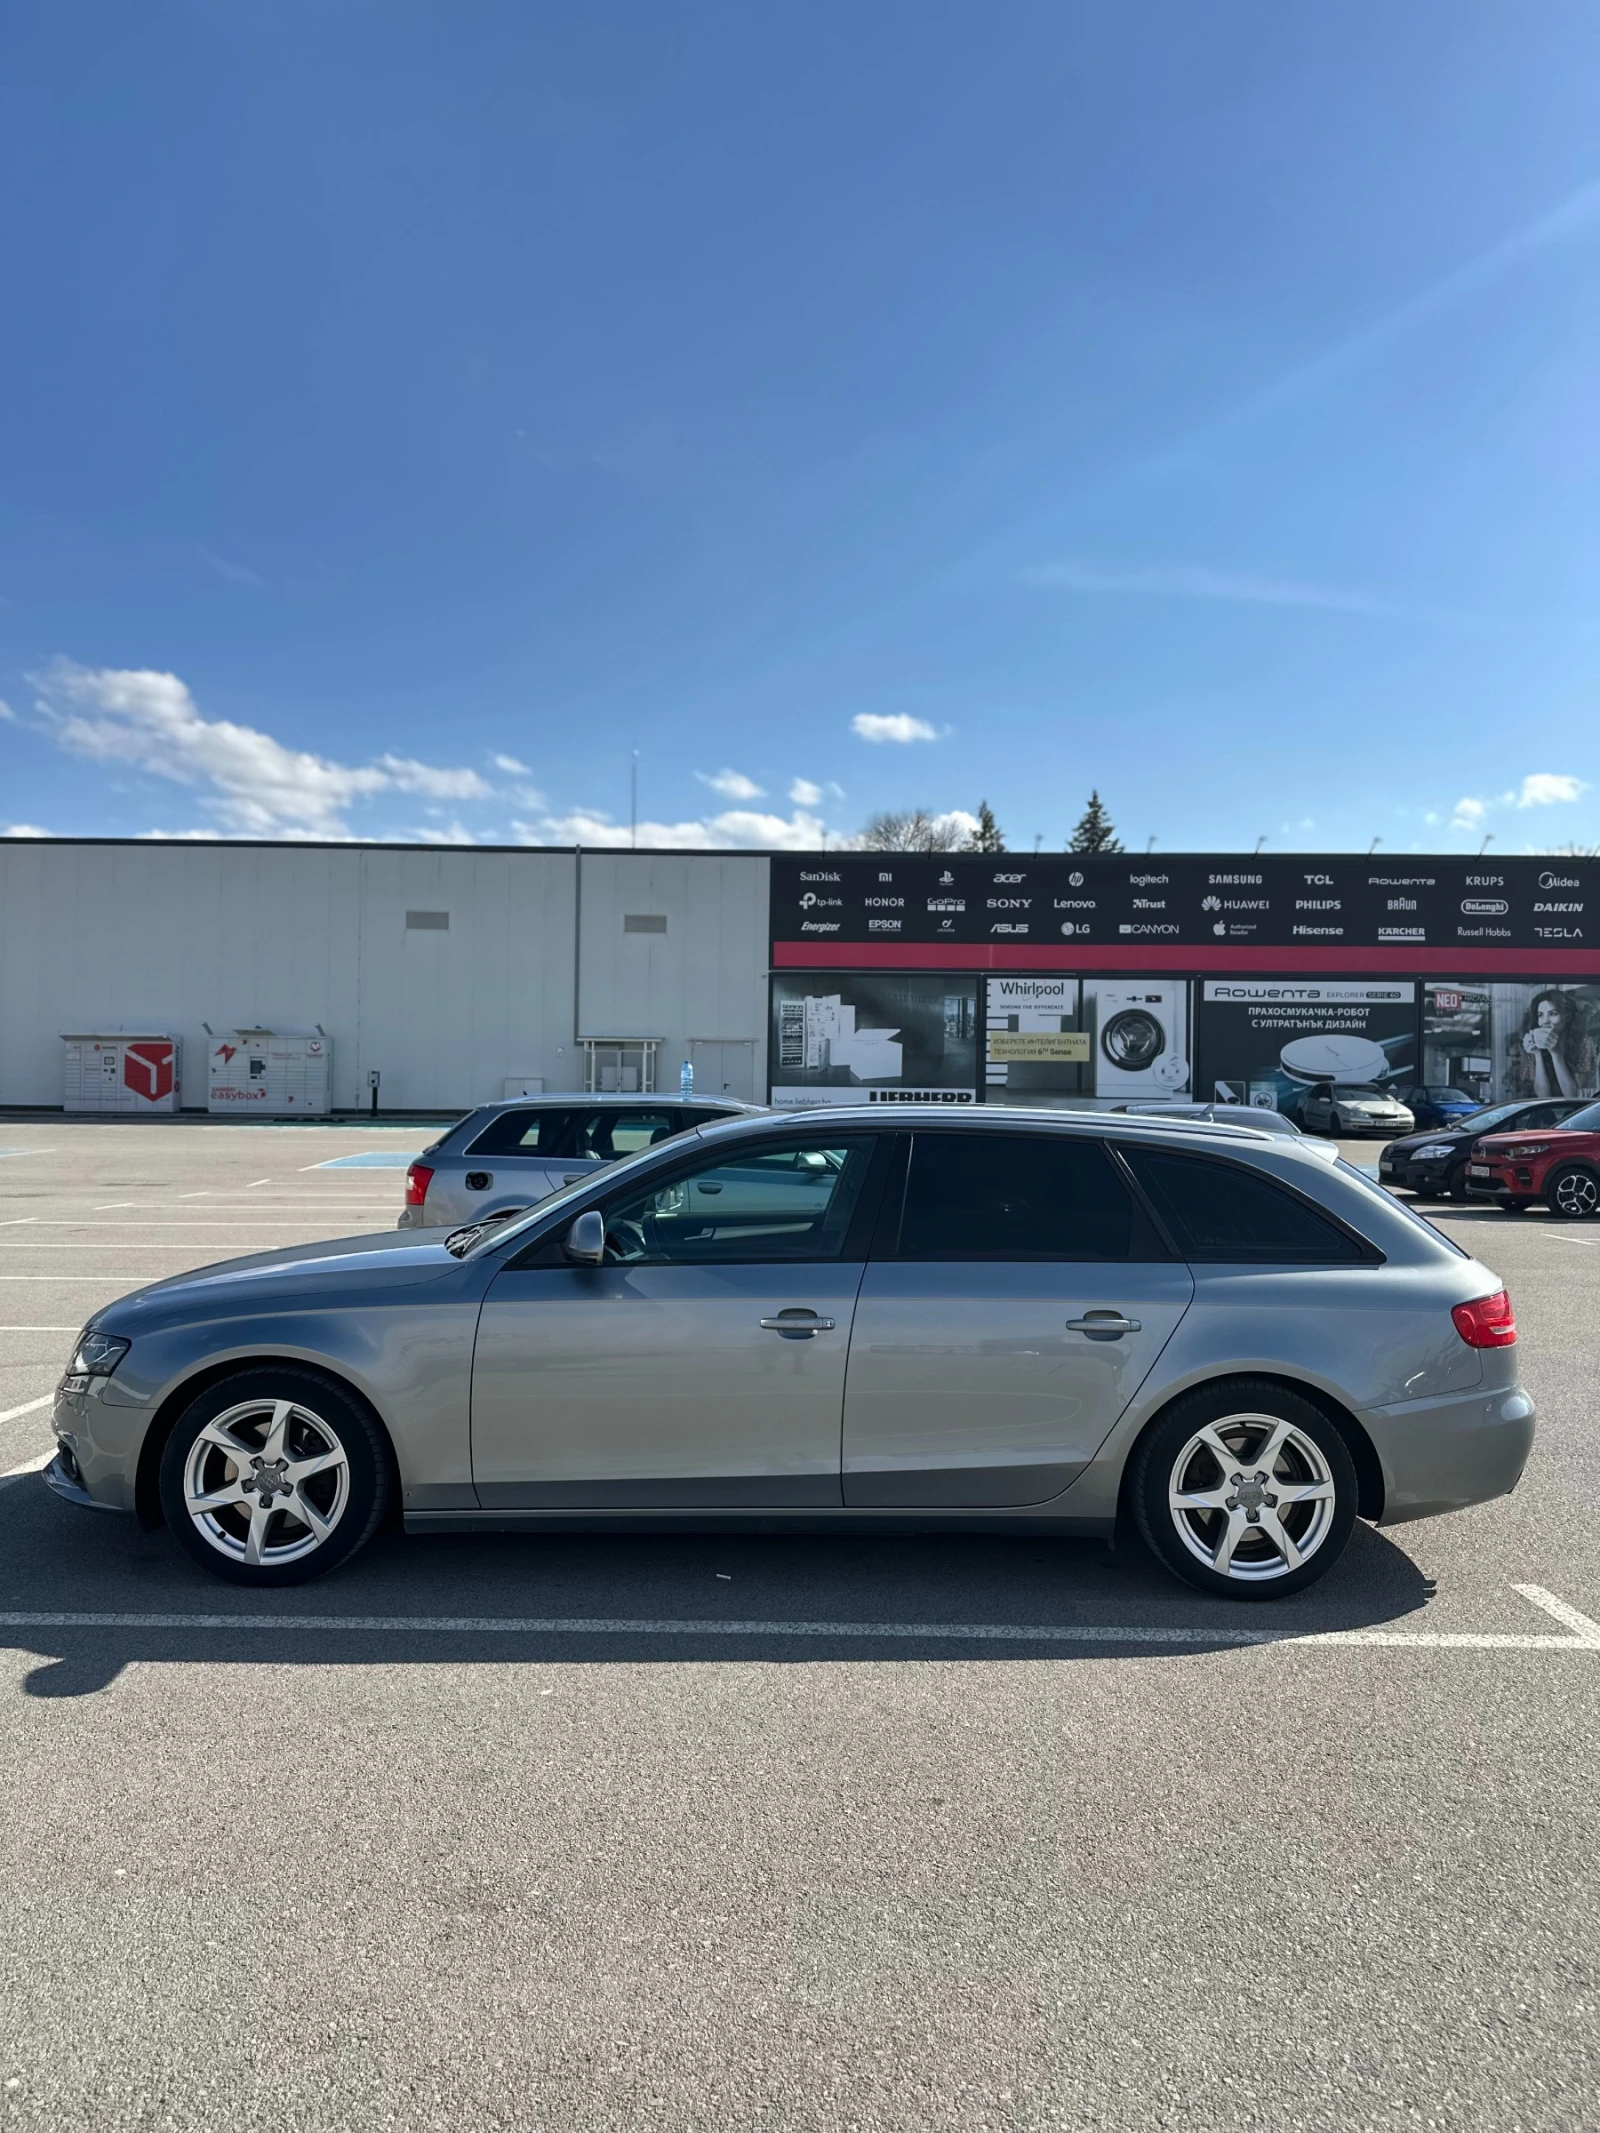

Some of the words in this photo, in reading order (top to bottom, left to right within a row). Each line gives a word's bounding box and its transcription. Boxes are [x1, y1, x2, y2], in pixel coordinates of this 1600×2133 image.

[800, 871, 841, 882] SanDisk
[993, 873, 1026, 884] acer
[1130, 874, 1169, 886] logitech
[1208, 875, 1263, 885] SAMSUNG
[1304, 875, 1334, 885] TCL
[1465, 876, 1504, 886] KRUPS
[1546, 874, 1580, 888] Midea
[817, 897, 843, 907] tp-link
[865, 897, 905, 907] HONOR
[986, 898, 1032, 909] SONY
[1054, 898, 1096, 909] Lenovo
[1224, 899, 1269, 910] HUAWEI
[1295, 900, 1341, 910] PHILIPS
[1387, 897, 1417, 911] BRAUN
[1533, 903, 1584, 912] DAIKIN
[801, 921, 841, 933] Energizer
[868, 919, 902, 929] EPSON
[990, 924, 1029, 933] ASUS
[1131, 924, 1180, 934] CANYON
[1076, 925, 1090, 934] LG
[1293, 925, 1344, 935] Hisense
[1457, 927, 1484, 936] Russell
[1487, 928, 1511, 937] Hobbs
[1000, 982, 1064, 998] Whirlpool
[1436, 993, 1458, 1008] NEO
[1248, 1007, 1370, 1017] ПРАХОСМУКАЧКА-РОБОТ
[1251, 1019, 1258, 1028] С
[1260, 1019, 1323, 1028] УЛТРАТЪНЪК
[1325, 1019, 1366, 1029] ДИЗАЙН
[1050, 1048, 1072, 1056] Sense
[211, 1090, 259, 1101] easybox
